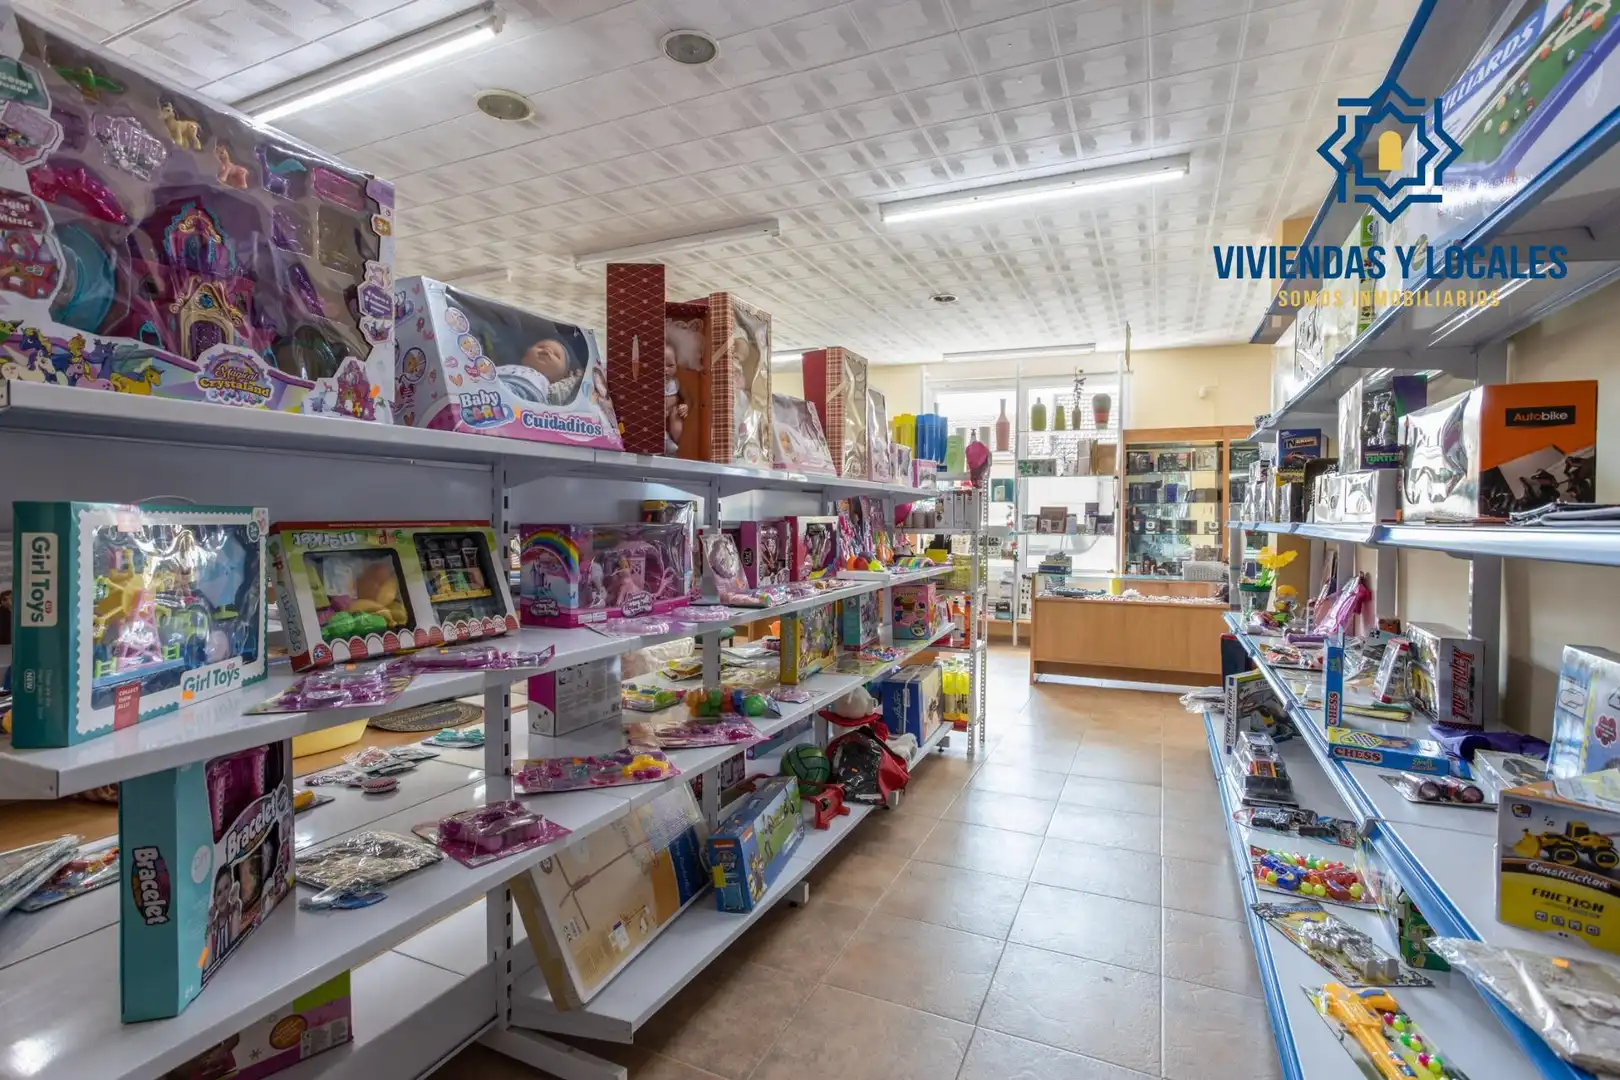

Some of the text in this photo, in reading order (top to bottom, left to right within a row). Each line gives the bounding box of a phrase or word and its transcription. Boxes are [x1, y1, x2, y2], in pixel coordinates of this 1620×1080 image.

[1437, 16, 1538, 115] ILLIARDS
[215, 363, 258, 381] Magical
[199, 376, 272, 398] Crystaland
[459, 389, 501, 408] Baby
[522, 411, 602, 436] Cuidaditos
[1513, 411, 1568, 421] Autobike
[26, 536, 51, 623] Girl Toys
[25, 671, 33, 690] NEW
[183, 667, 240, 693] Girl Toys
[1329, 692, 1339, 725] CHESS
[1333, 746, 1382, 761] CHESS
[227, 791, 276, 864] Bracelet
[133, 847, 168, 926] Bracelet
[1527, 861, 1610, 889] Construction
[1531, 887, 1605, 914] FRICTION
